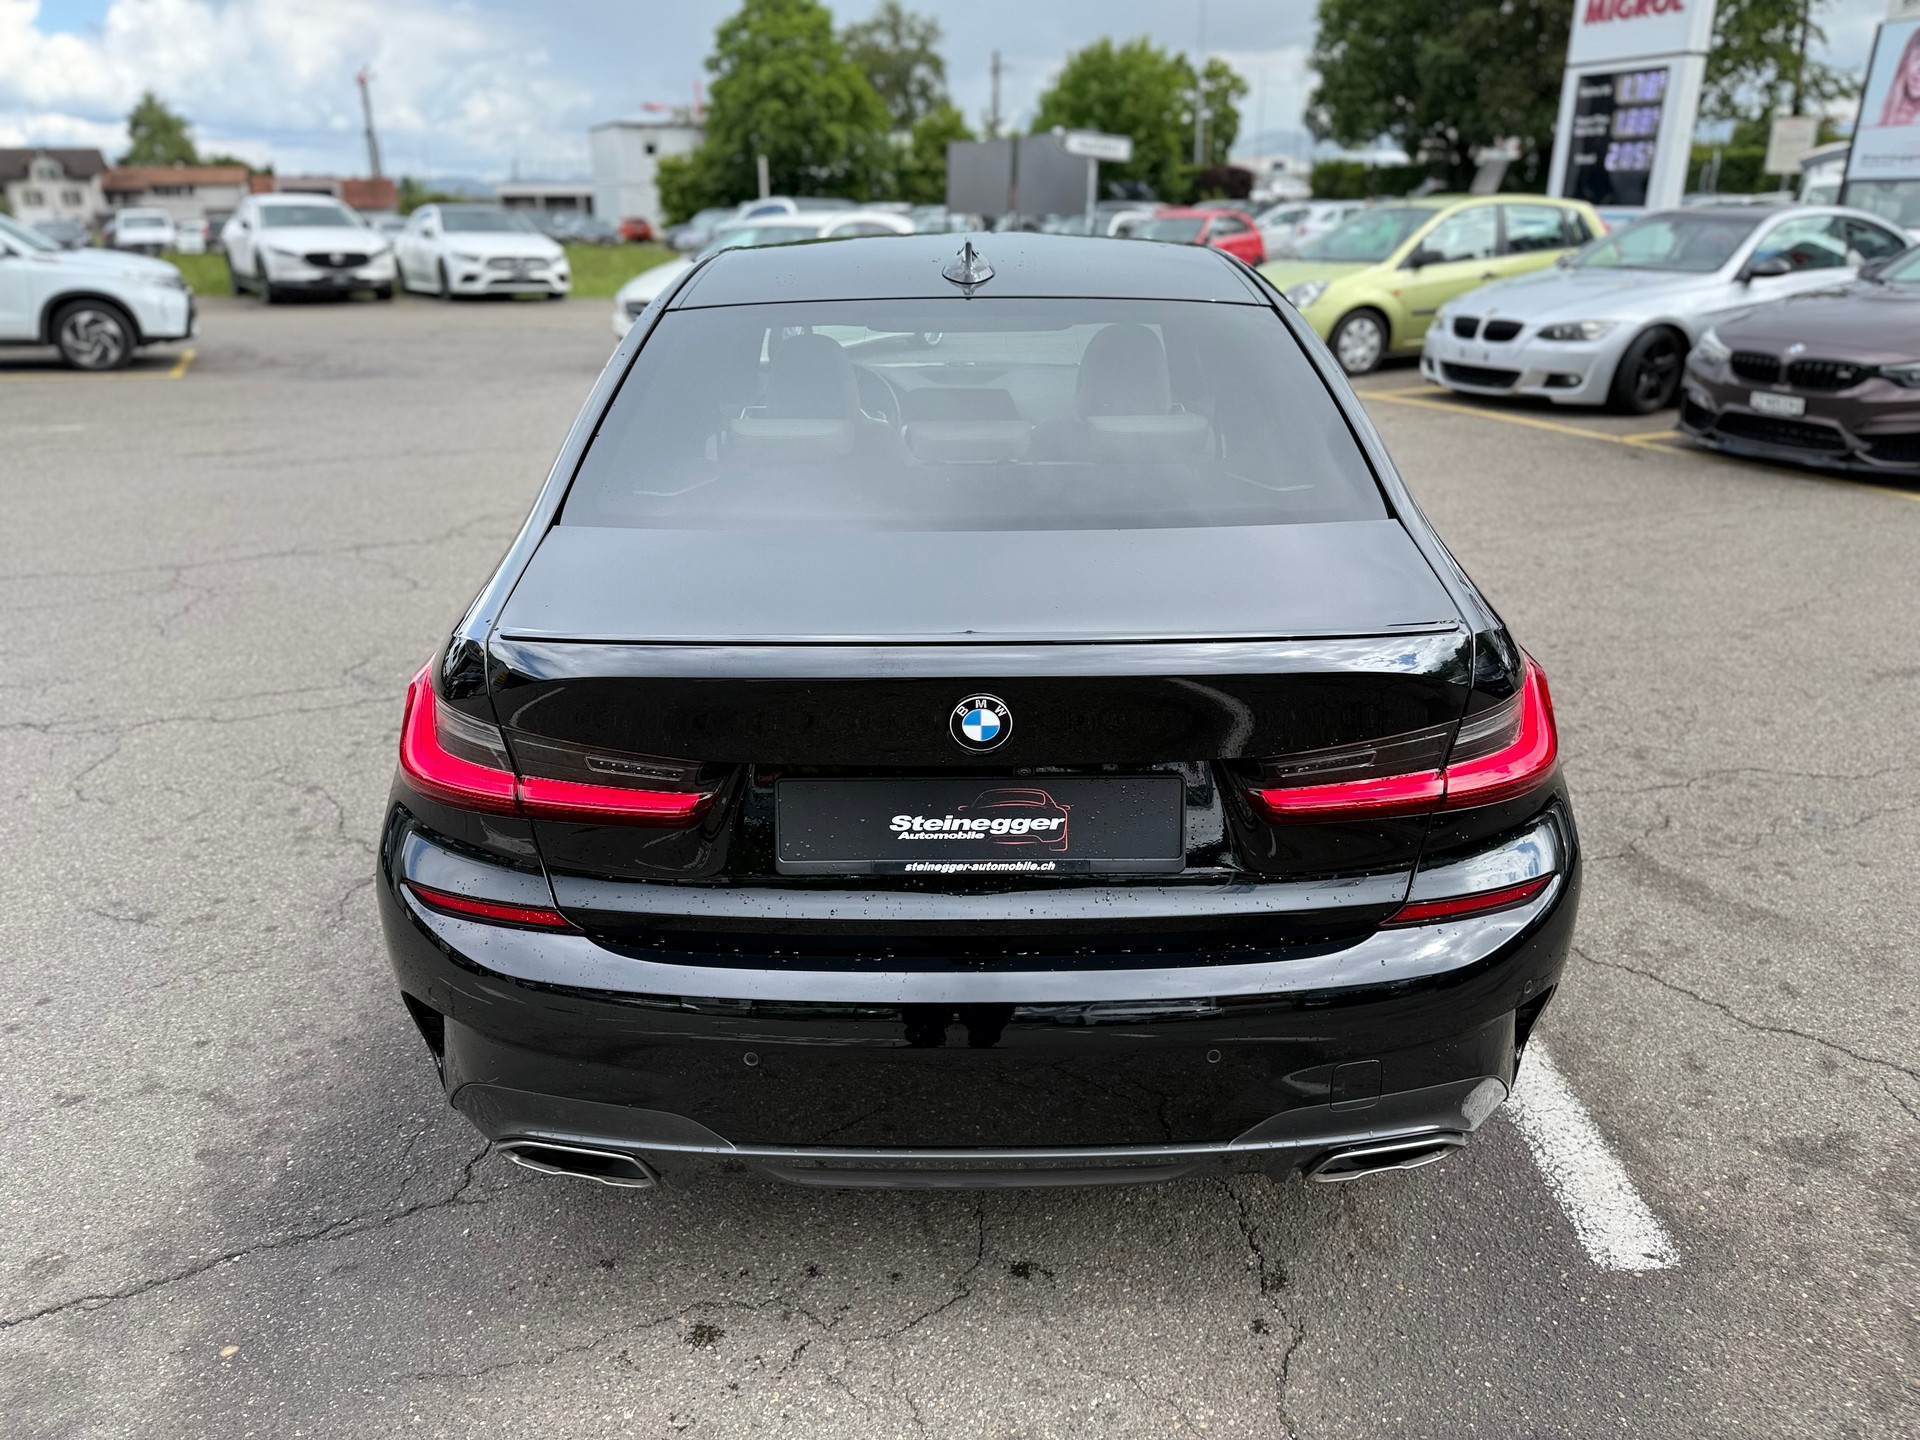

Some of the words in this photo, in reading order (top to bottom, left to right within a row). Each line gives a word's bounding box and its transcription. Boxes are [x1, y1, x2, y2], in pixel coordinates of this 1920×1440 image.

[956, 699, 1007, 717] BMW
[889, 814, 1066, 835] Steinegger
[897, 831, 985, 840] Automobile
[904, 861, 1056, 874] steinegger-automobile.ch
